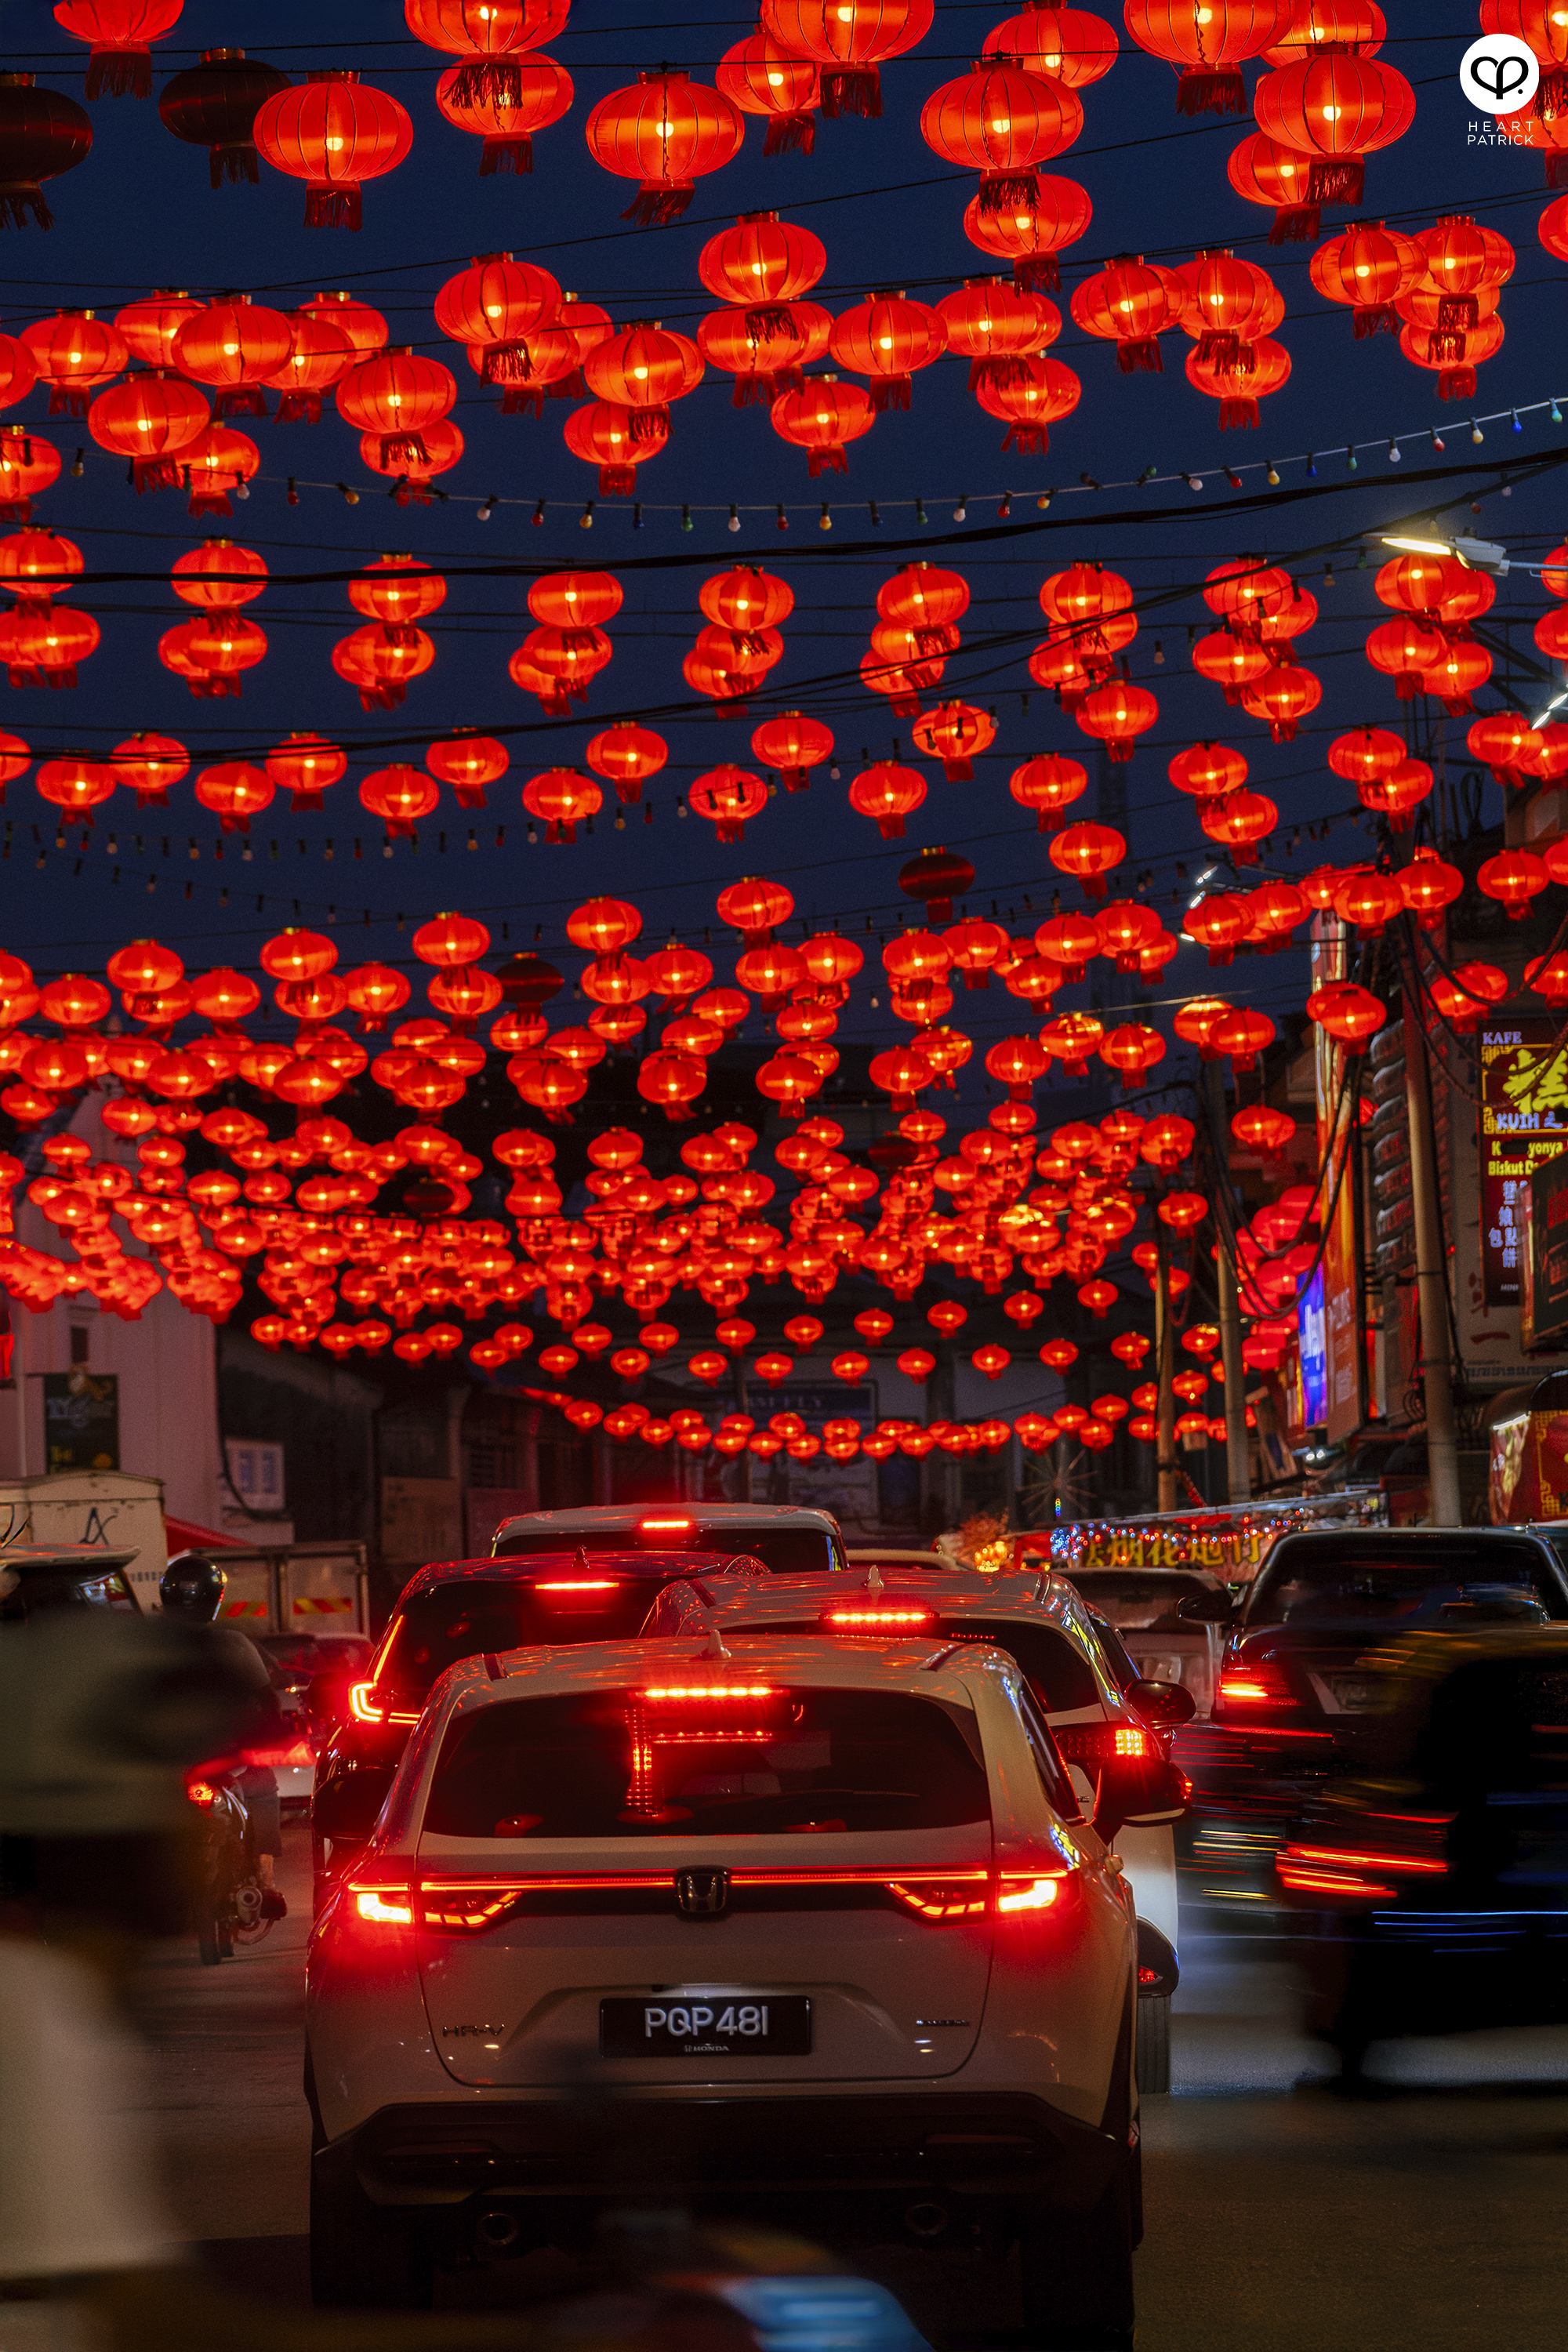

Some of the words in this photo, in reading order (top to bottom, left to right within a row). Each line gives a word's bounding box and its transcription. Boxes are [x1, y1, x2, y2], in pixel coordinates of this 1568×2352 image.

[1483, 1031, 1522, 1045] KAFE
[1497, 1112, 1539, 1131] KUIH
[1527, 1142, 1564, 1160] yonya
[1488, 1160, 1524, 1176] Biskut
